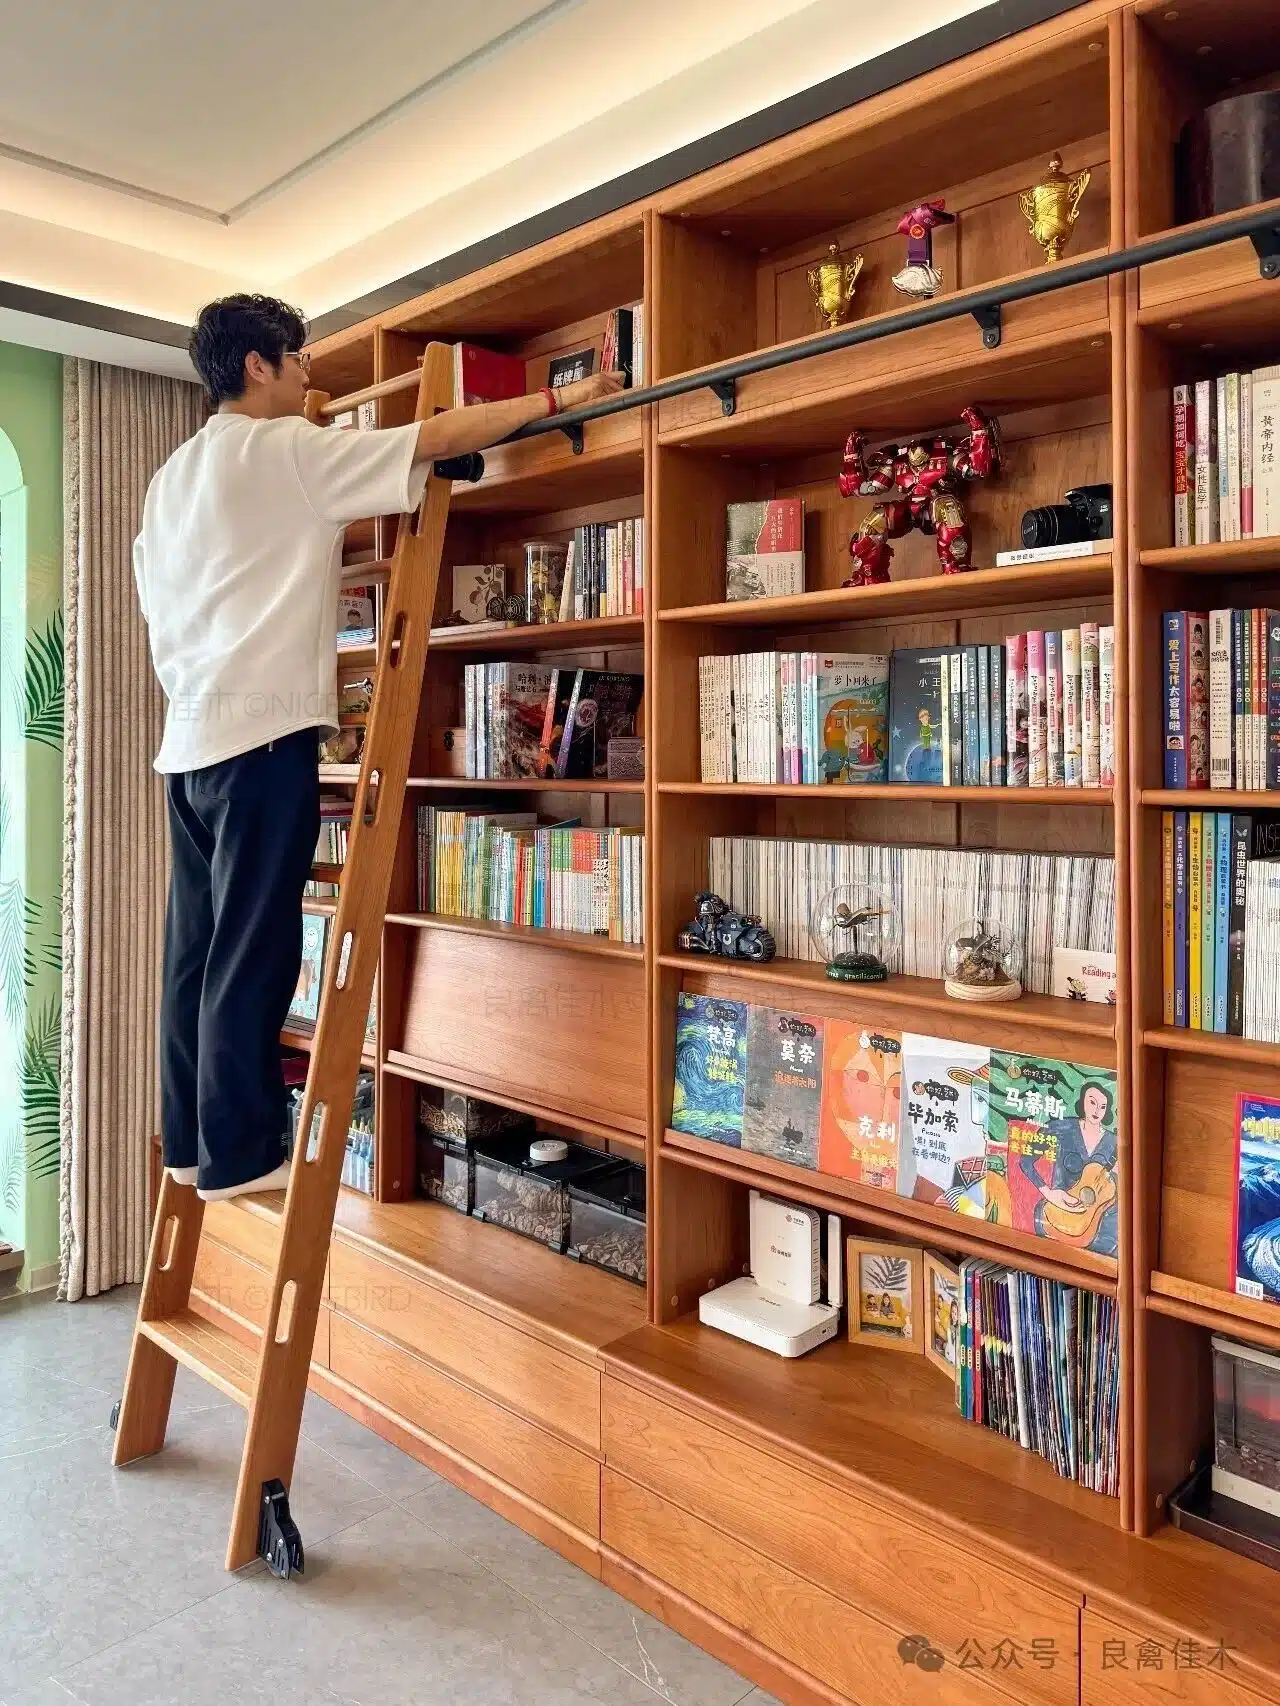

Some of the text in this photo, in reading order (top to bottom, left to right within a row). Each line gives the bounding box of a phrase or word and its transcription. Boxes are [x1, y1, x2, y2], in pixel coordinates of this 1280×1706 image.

[1260, 415, 1275, 464] 黄帝内经
[1197, 466, 1208, 504] 女性医学
[833, 675, 878, 687] 萝卜回来了
[1168, 639, 1182, 732] 爱上写作太容易啦
[1234, 841, 1247, 906] 昆虫世界的奥秘
[1081, 966, 1111, 979] Reading
[706, 1024, 736, 1049] 梵高
[780, 1039, 816, 1064] 莫奈
[1005, 1087, 1067, 1120] 马蒂斯
[858, 1115, 896, 1142] 克利
[908, 1102, 959, 1134] 毕加索
[1011, 1126, 1058, 1146] 真的好想
[911, 1148, 951, 1164] 在看哪边?
